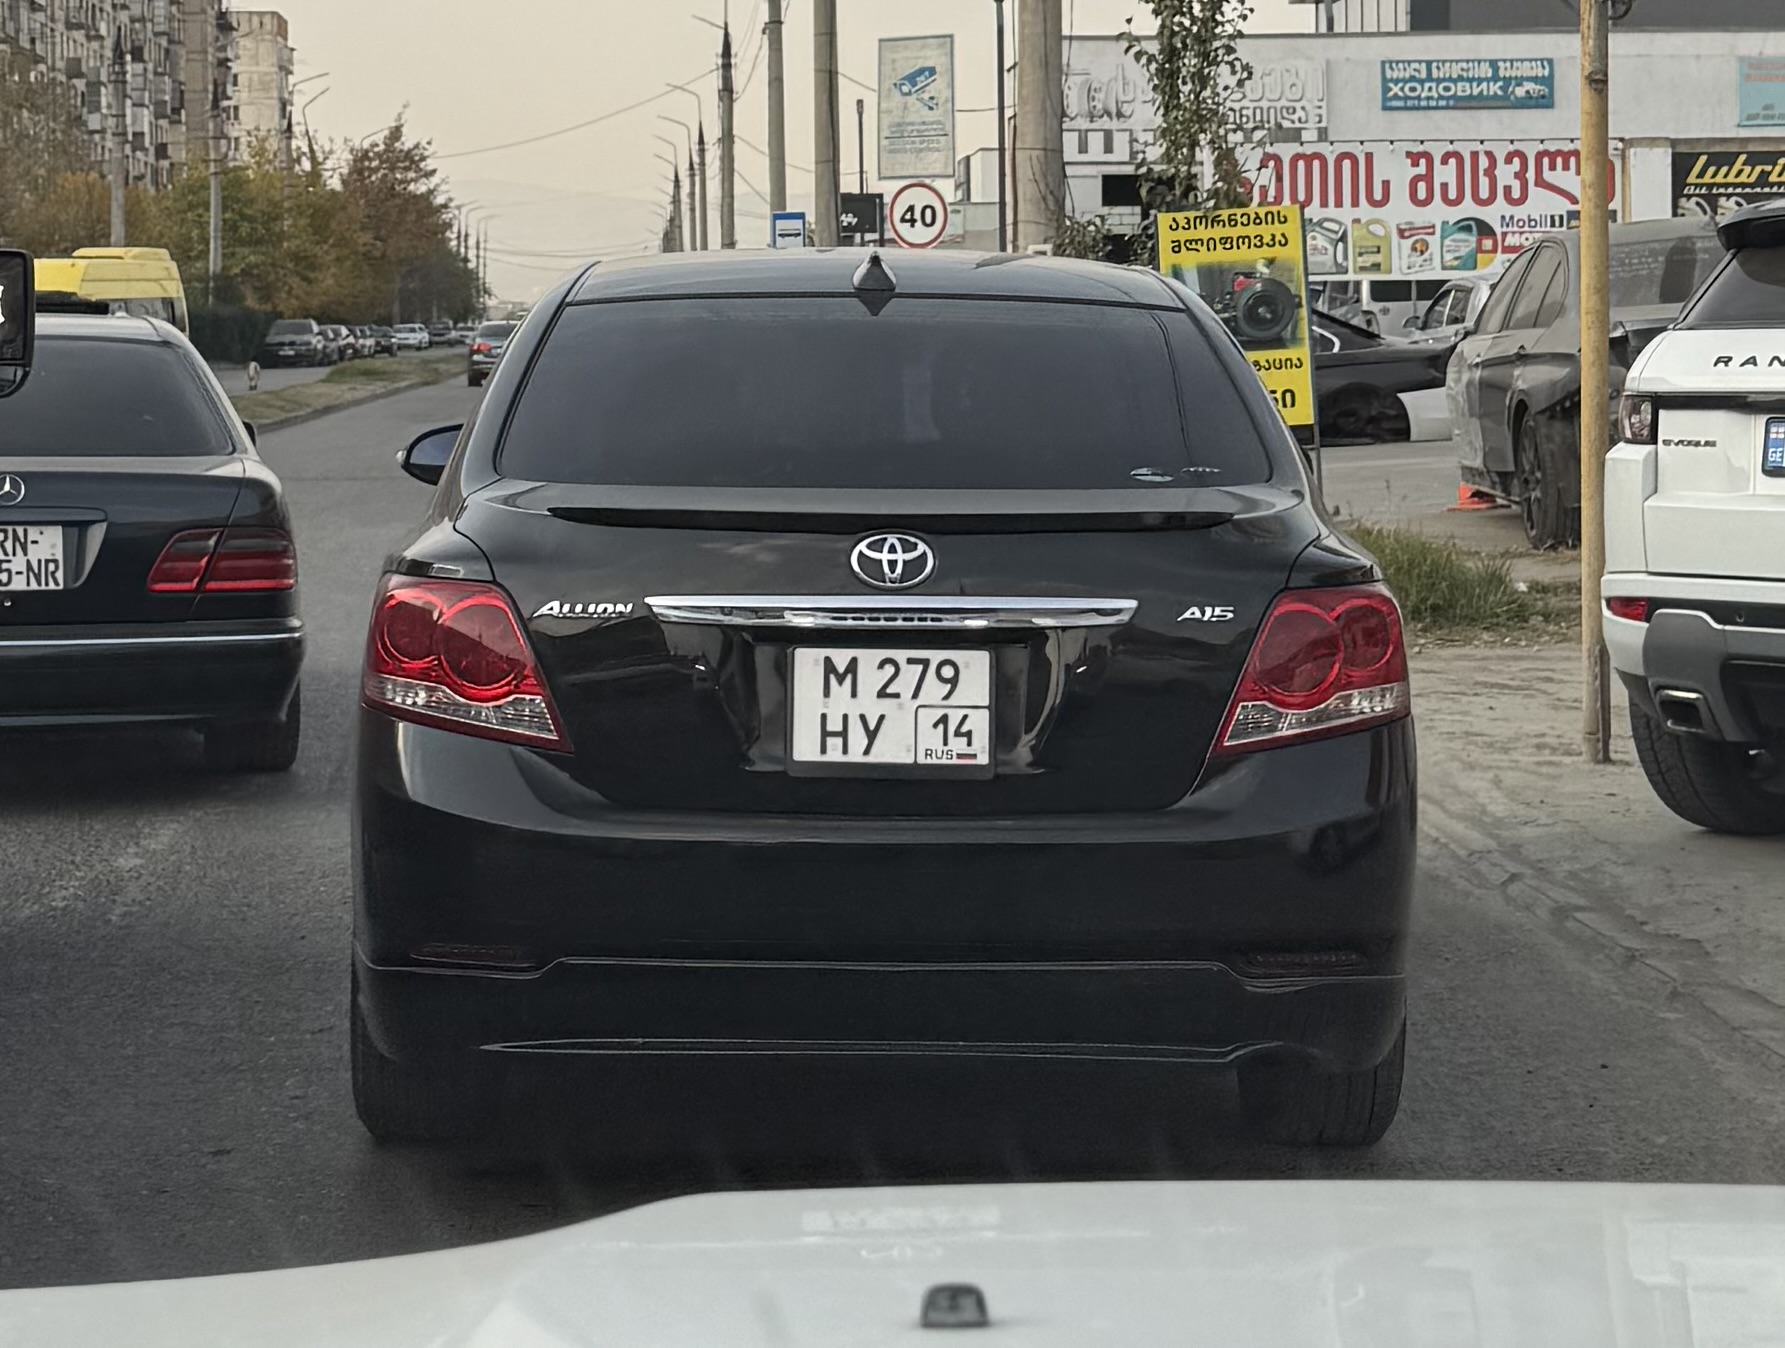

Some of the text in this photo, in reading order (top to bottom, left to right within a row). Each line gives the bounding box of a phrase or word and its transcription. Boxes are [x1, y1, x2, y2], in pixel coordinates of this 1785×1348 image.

[1387, 81, 1504, 98] ХОДОВИК
[1237, 150, 1391, 208] ეთის
[900, 204, 937, 228] 40
[1500, 214, 1548, 228] Mobil
[1662, 439, 1717, 448] EVOQUE
[1768, 448, 1784, 462] GE
[1177, 606, 1235, 621] A15
[876, 657, 960, 700] 279
[932, 713, 972, 747] 14
[925, 749, 954, 760] RUS
